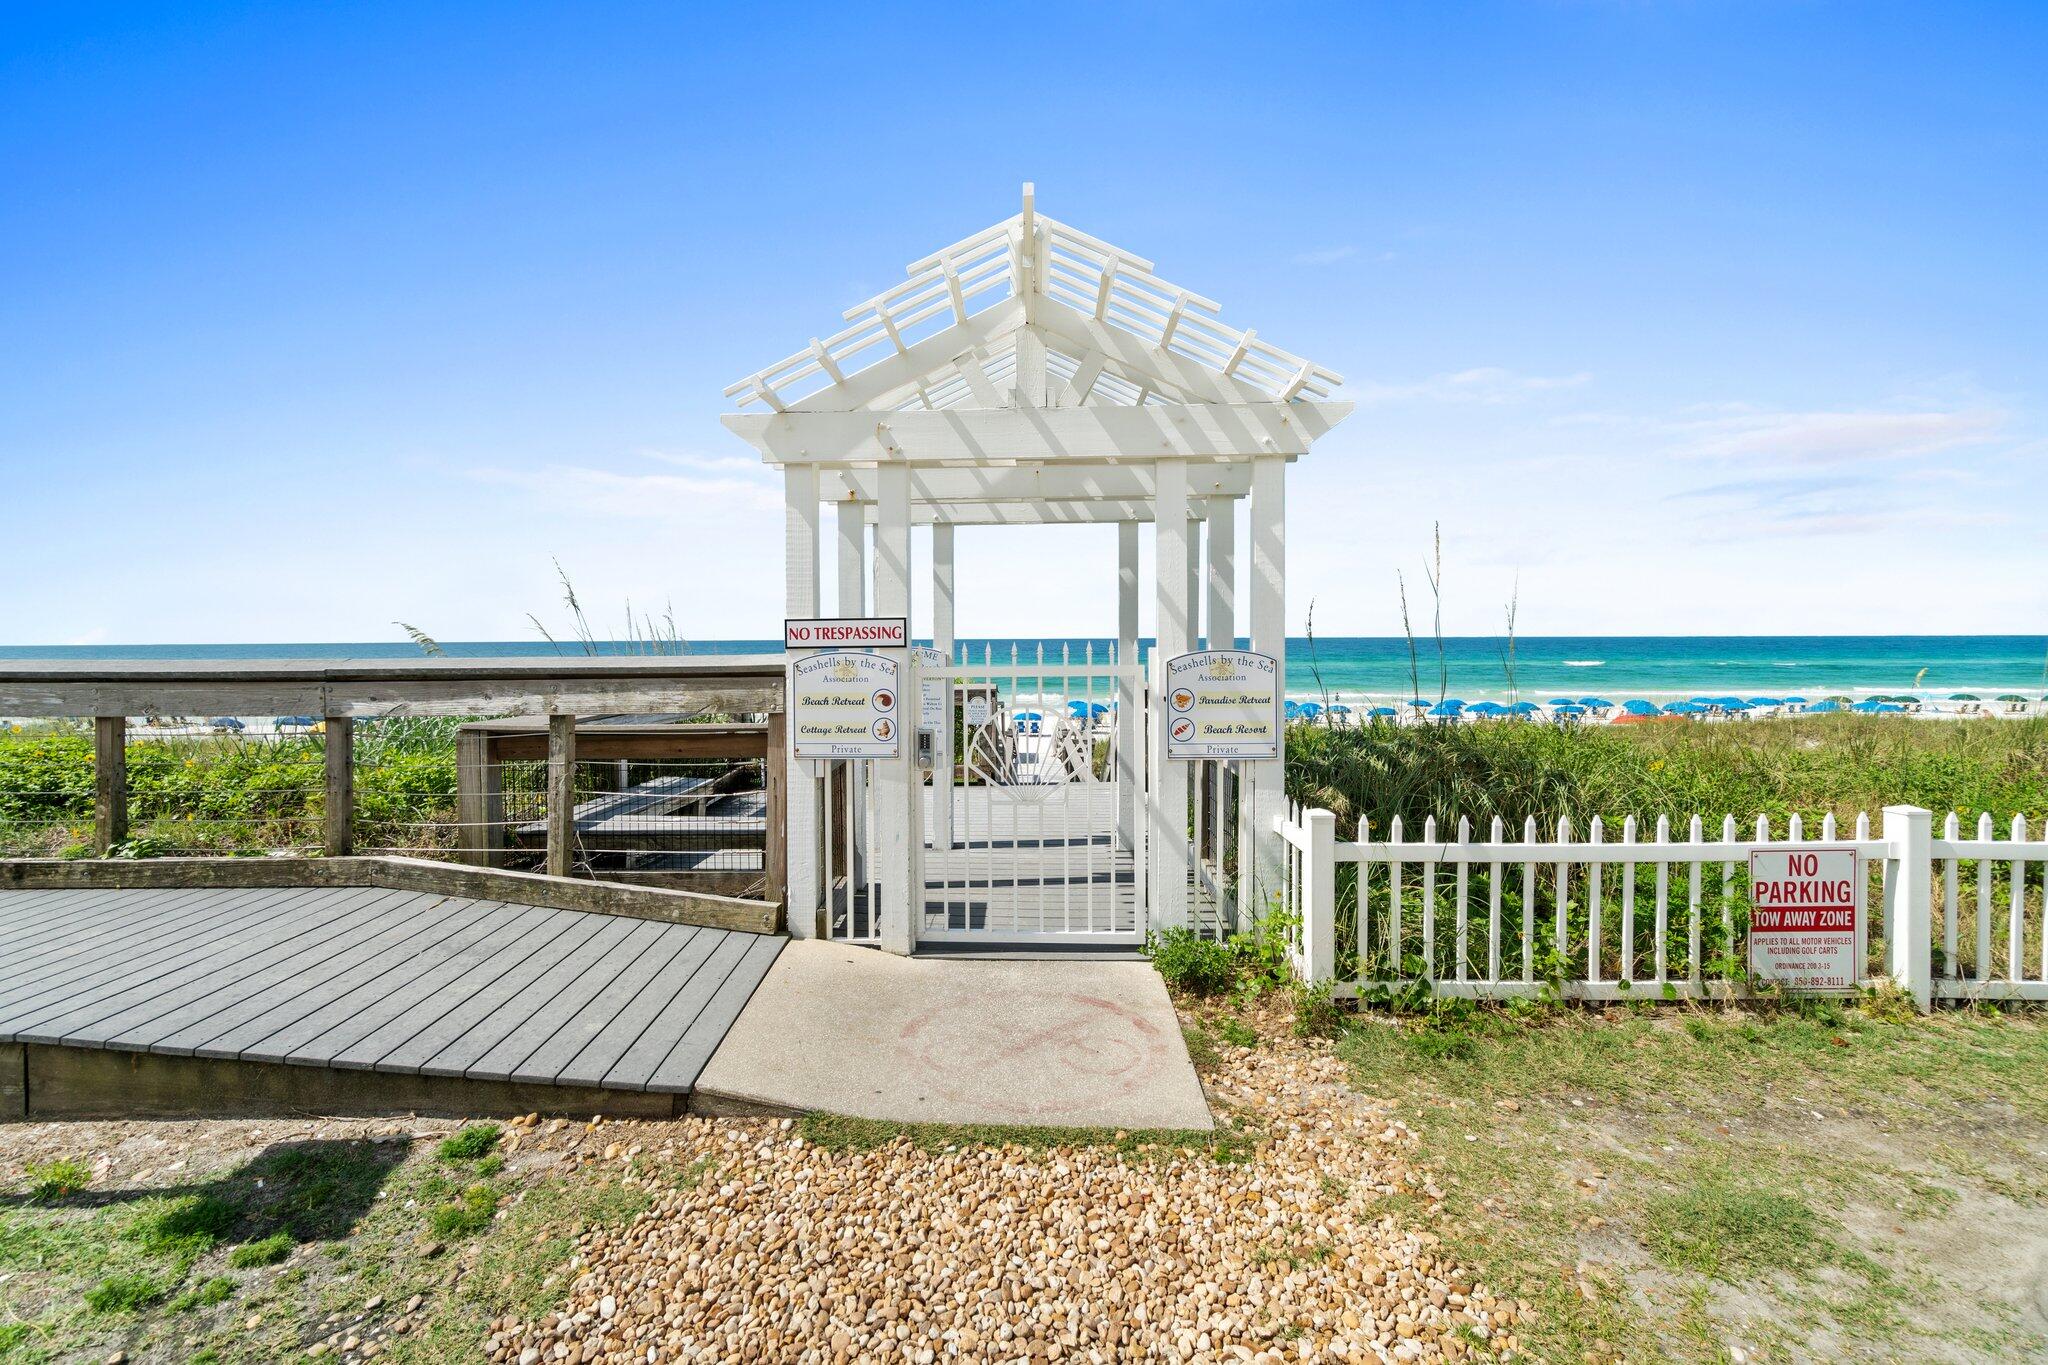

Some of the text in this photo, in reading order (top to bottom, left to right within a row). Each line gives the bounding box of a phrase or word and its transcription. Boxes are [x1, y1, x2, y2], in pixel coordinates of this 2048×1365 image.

[789, 626, 902, 641] NO TRESPASSING
[797, 657, 895, 676] Seashells by the Sea
[1170, 654, 1274, 675] Seashells by the Sea
[822, 675, 869, 683] Association
[1198, 674, 1247, 682] Association
[802, 696, 865, 706] Beach Retreat
[1199, 695, 1271, 705] Paradise Retreat
[800, 725, 867, 735] Cottage Retreat
[1203, 724, 1267, 734] Beach Resort
[831, 745, 862, 754] Private
[1207, 745, 1239, 754] Private
[1788, 854, 1818, 877] NO
[1755, 880, 1851, 904] PARKING
[1754, 910, 1852, 927] TOW AWAY ZONE
[1801, 937, 1823, 945] MOTOR
[1824, 937, 1852, 945] VEHICLES
[1767, 947, 1800, 955] INCLUDING
[1819, 946, 1838, 954] CARTS
[1774, 962, 1806, 970] ORDINANCE
